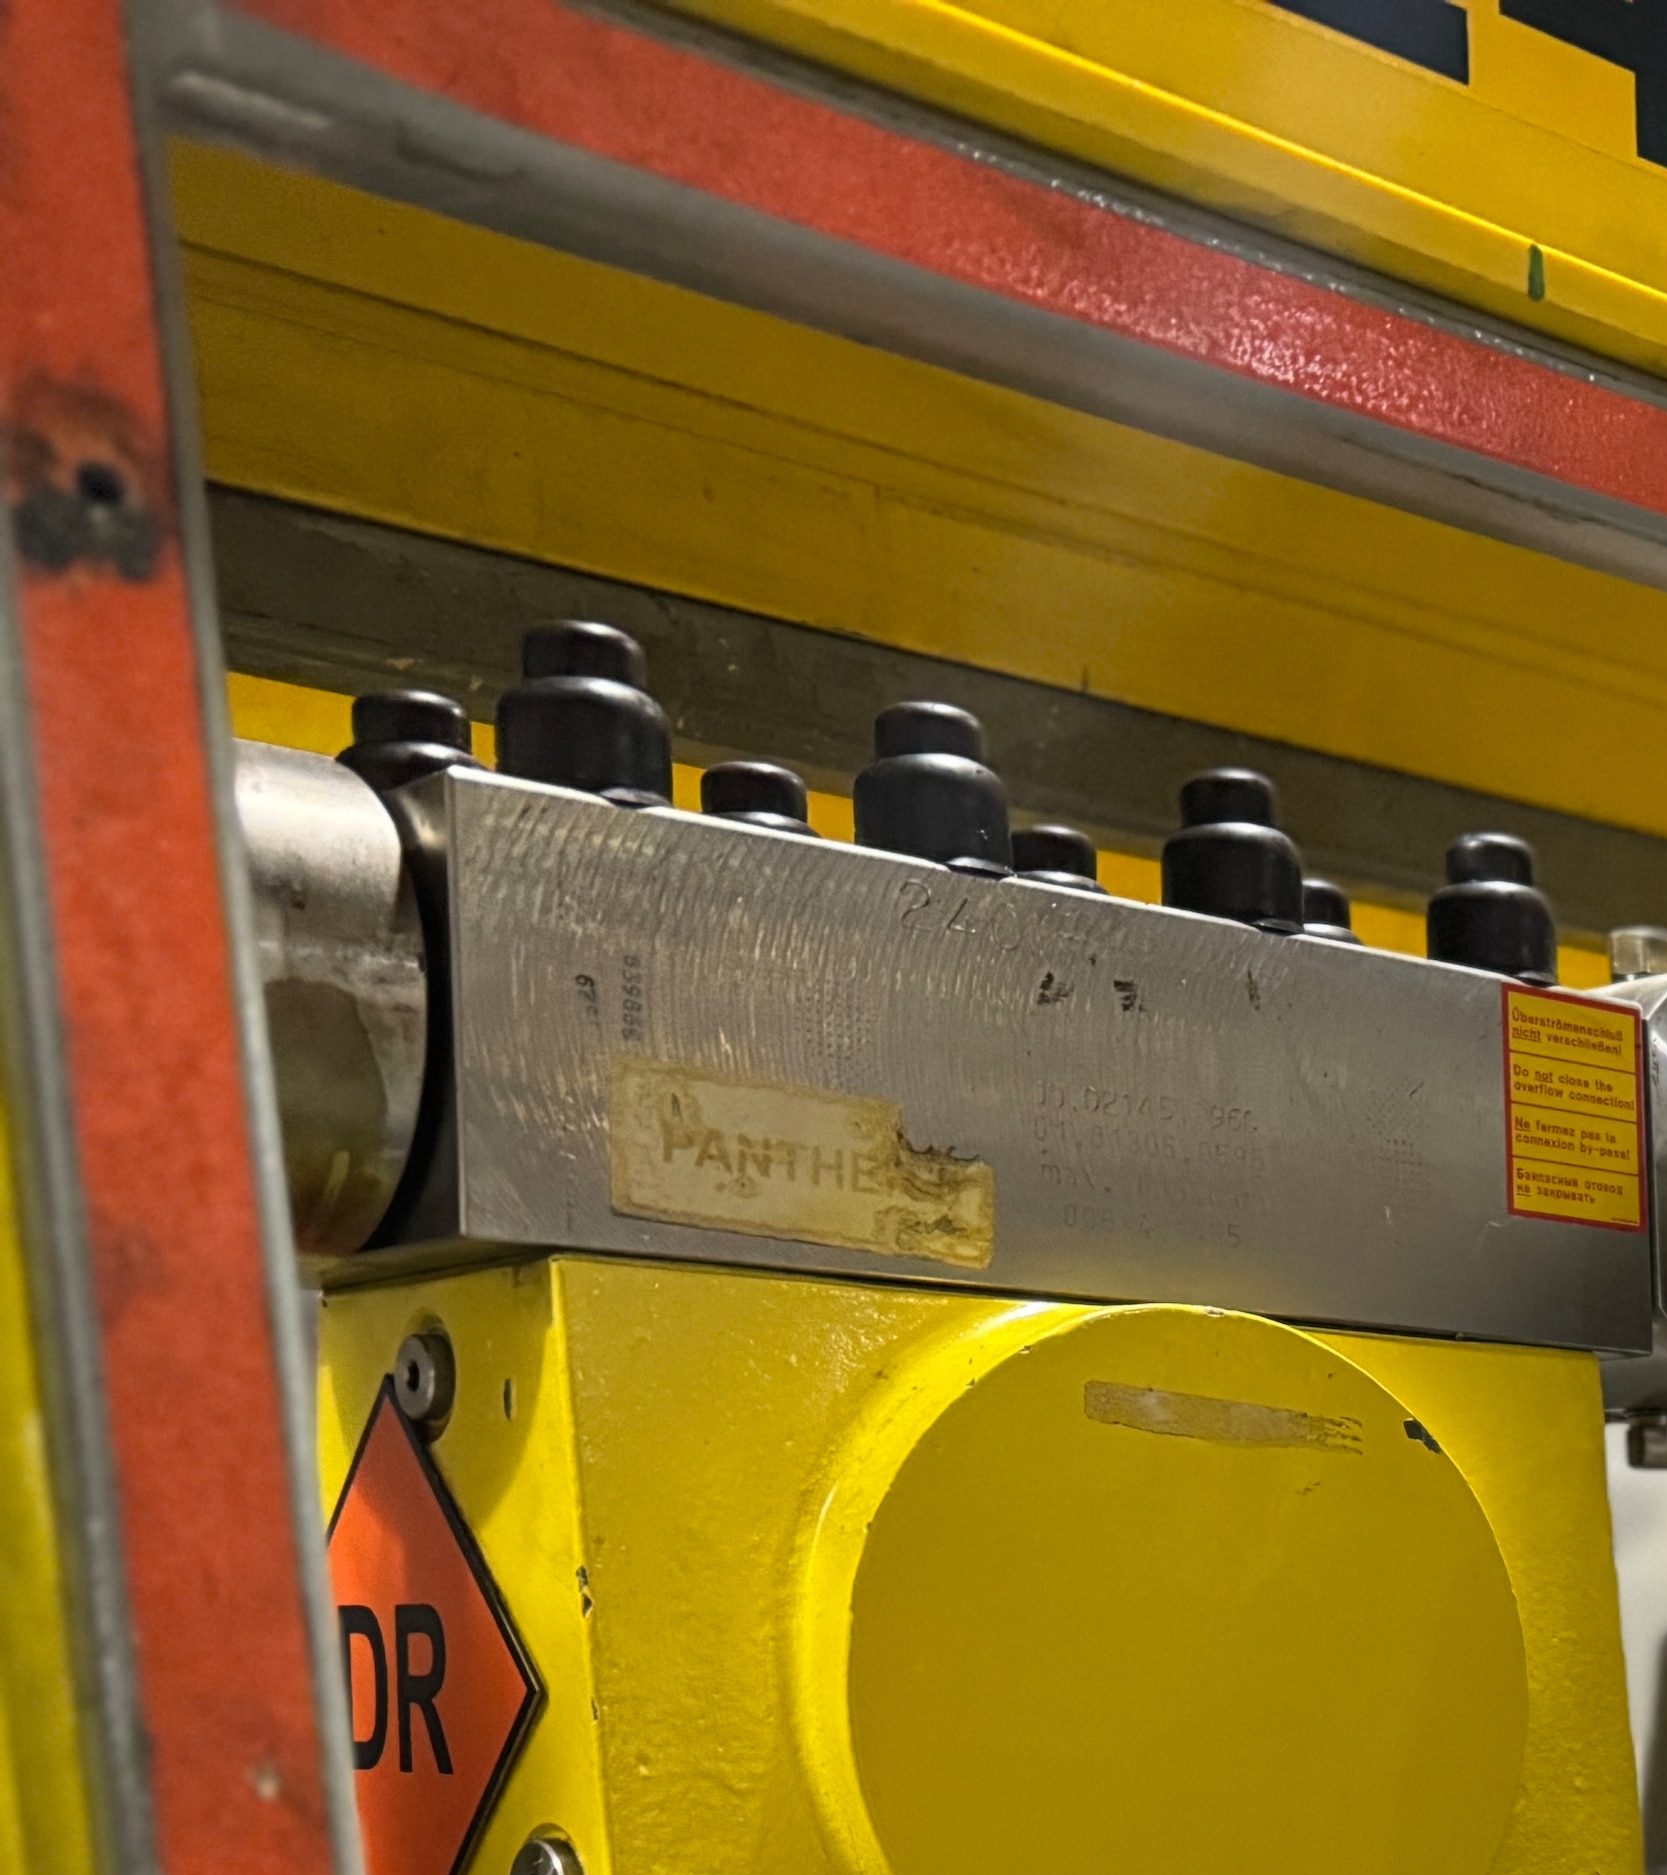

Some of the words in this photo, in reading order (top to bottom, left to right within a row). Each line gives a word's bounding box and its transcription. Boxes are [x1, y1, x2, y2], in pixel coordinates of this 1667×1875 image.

[1512, 1027, 1541, 1042] nicht
[1513, 1065, 1529, 1078] Do
[1535, 1069, 1553, 1083] not
[1558, 1074, 1590, 1088] close
[1595, 1078, 1613, 1092] the
[1513, 1081, 1564, 1099] overflow
[1515, 1116, 1531, 1131] Ne
[1536, 1120, 1575, 1137] fermez
[1581, 1127, 1601, 1141] pas
[1606, 1129, 1616, 1144] la
[1515, 1134, 1575, 1151] connexion
[662, 1119, 895, 1197] PANTHE
[1516, 1184, 1531, 1196] не
